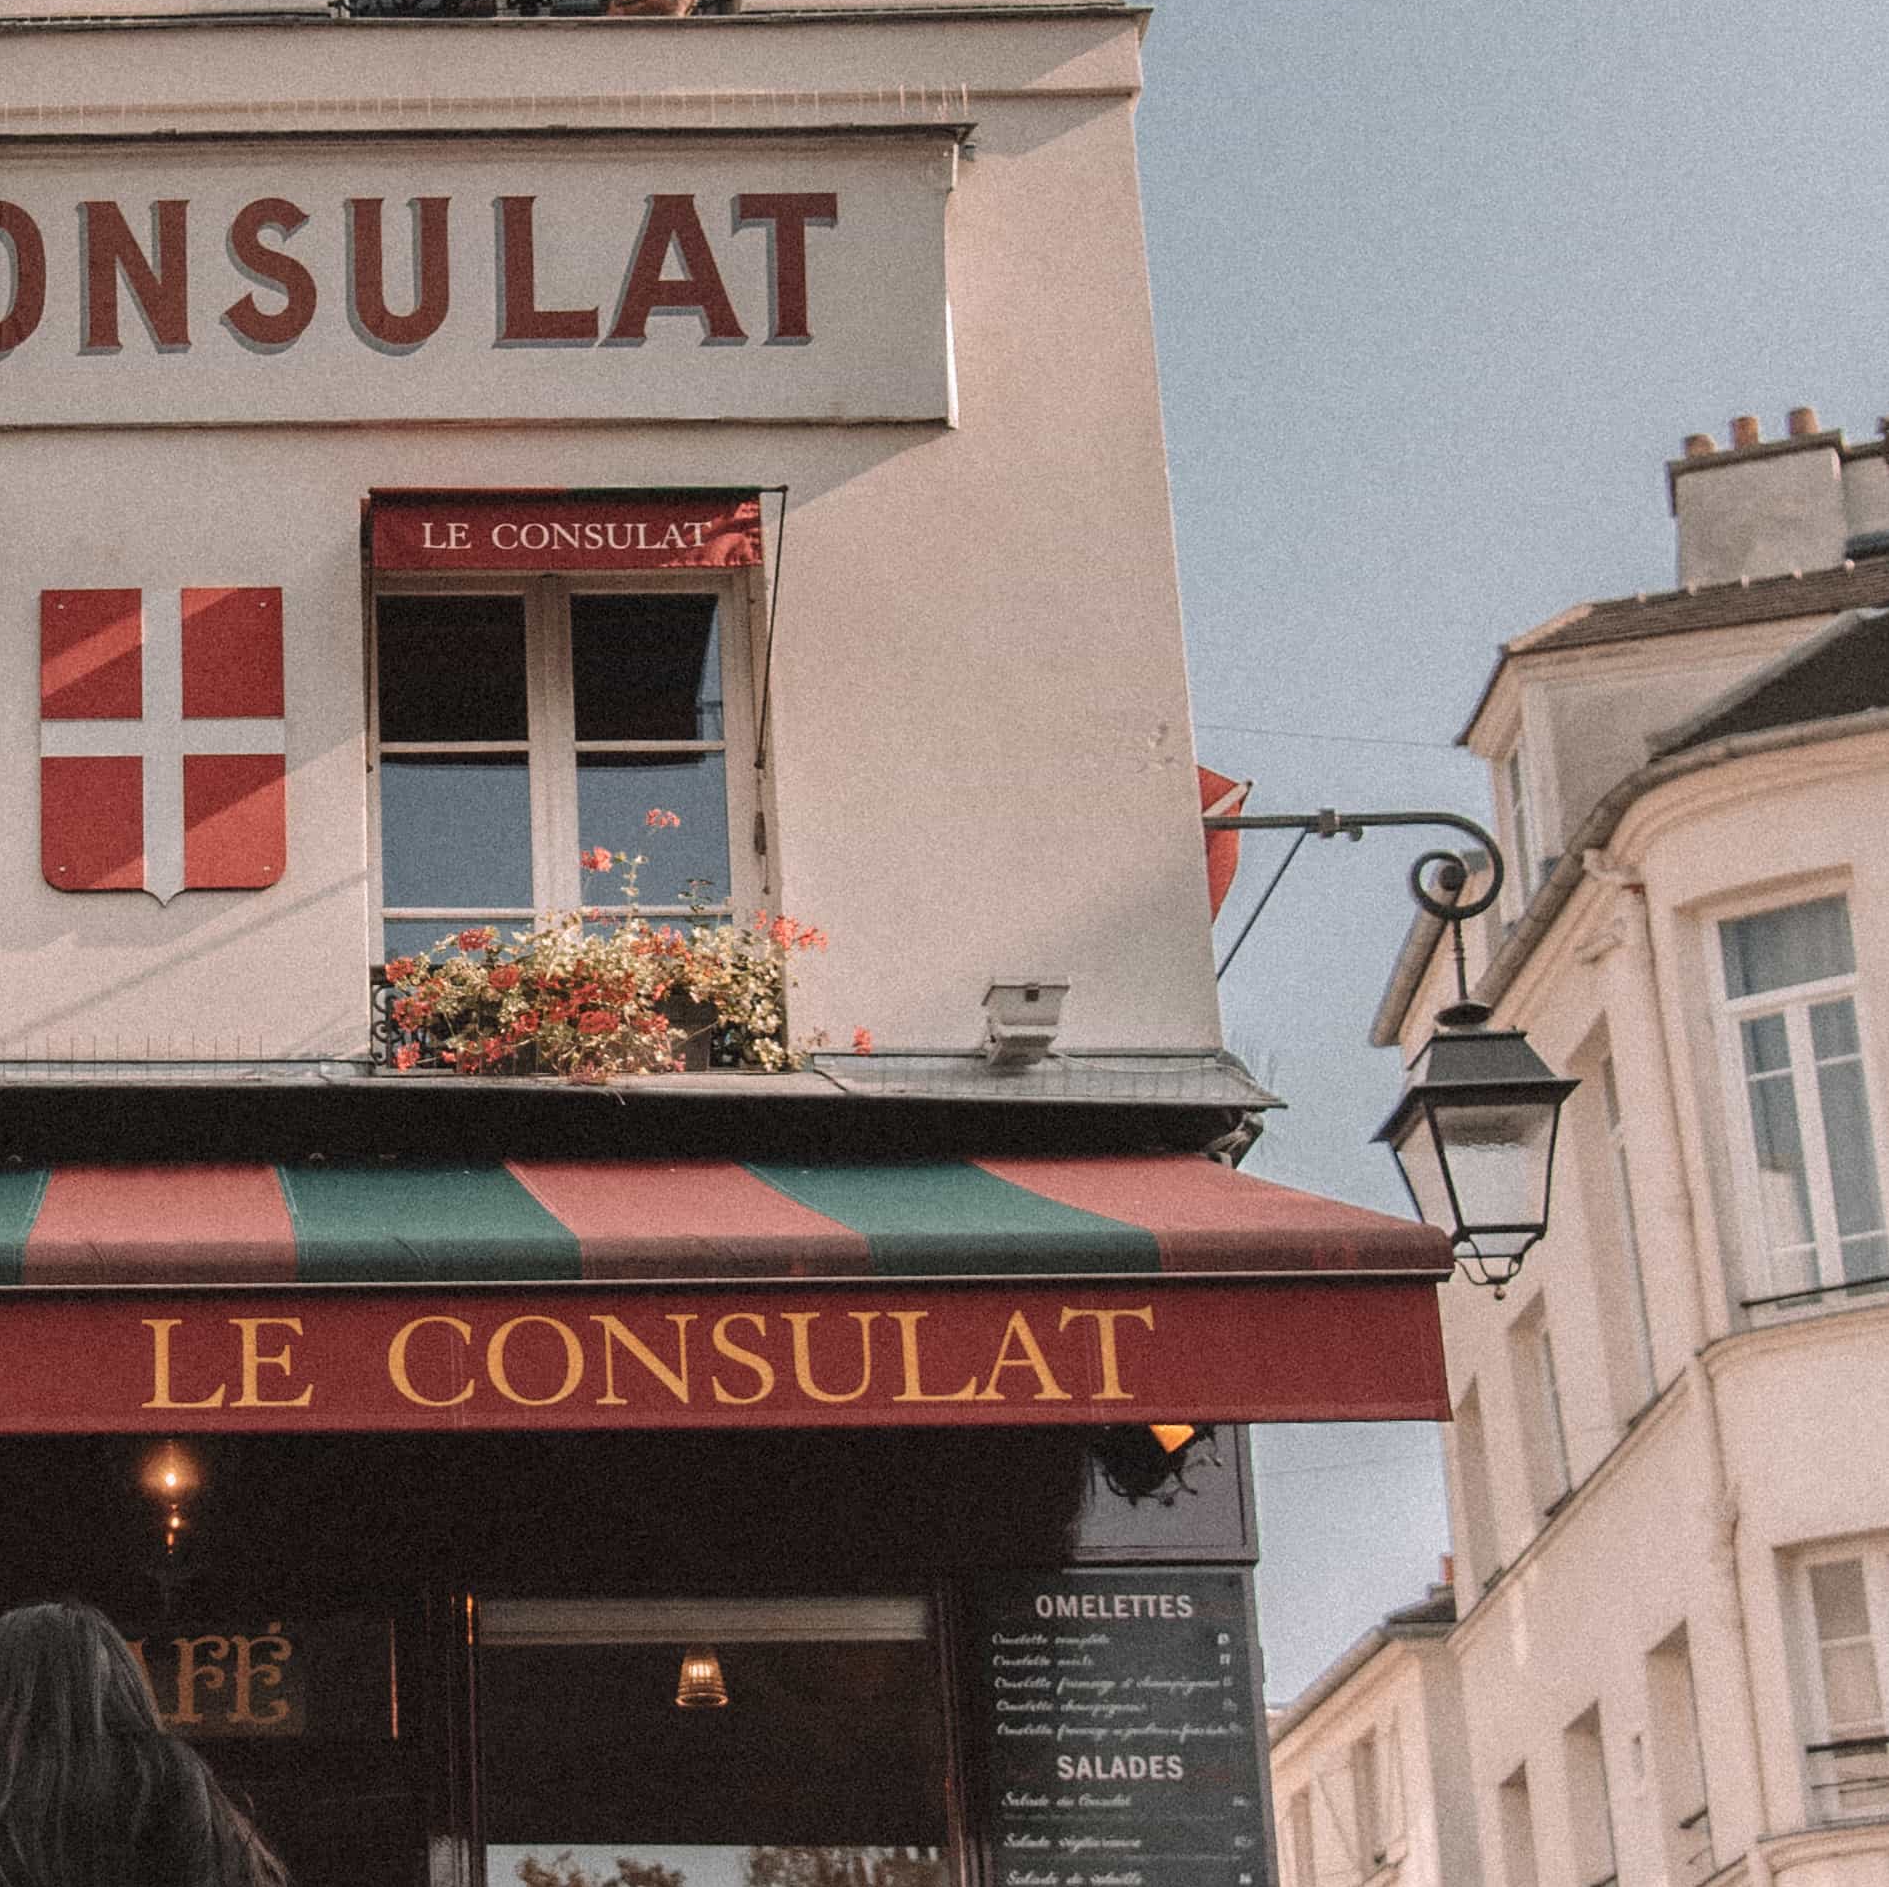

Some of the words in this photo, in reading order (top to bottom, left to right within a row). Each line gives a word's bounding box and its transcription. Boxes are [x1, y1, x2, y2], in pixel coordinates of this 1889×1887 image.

[422, 522, 471, 550] LE
[491, 520, 712, 551] CONSULAT
[141, 1316, 313, 1410] LE
[386, 1304, 1154, 1408] CONSULAT
[1035, 1594, 1193, 1618] OMELETTES
[992, 1632, 1049, 1646] Omelette
[993, 1654, 1052, 1667] Omelette
[1056, 1754, 1185, 1780] SALADES
[1001, 1791, 1050, 1807] Salade
[1003, 1833, 1052, 1849] Salade
[1006, 1870, 1060, 1886] Salade
